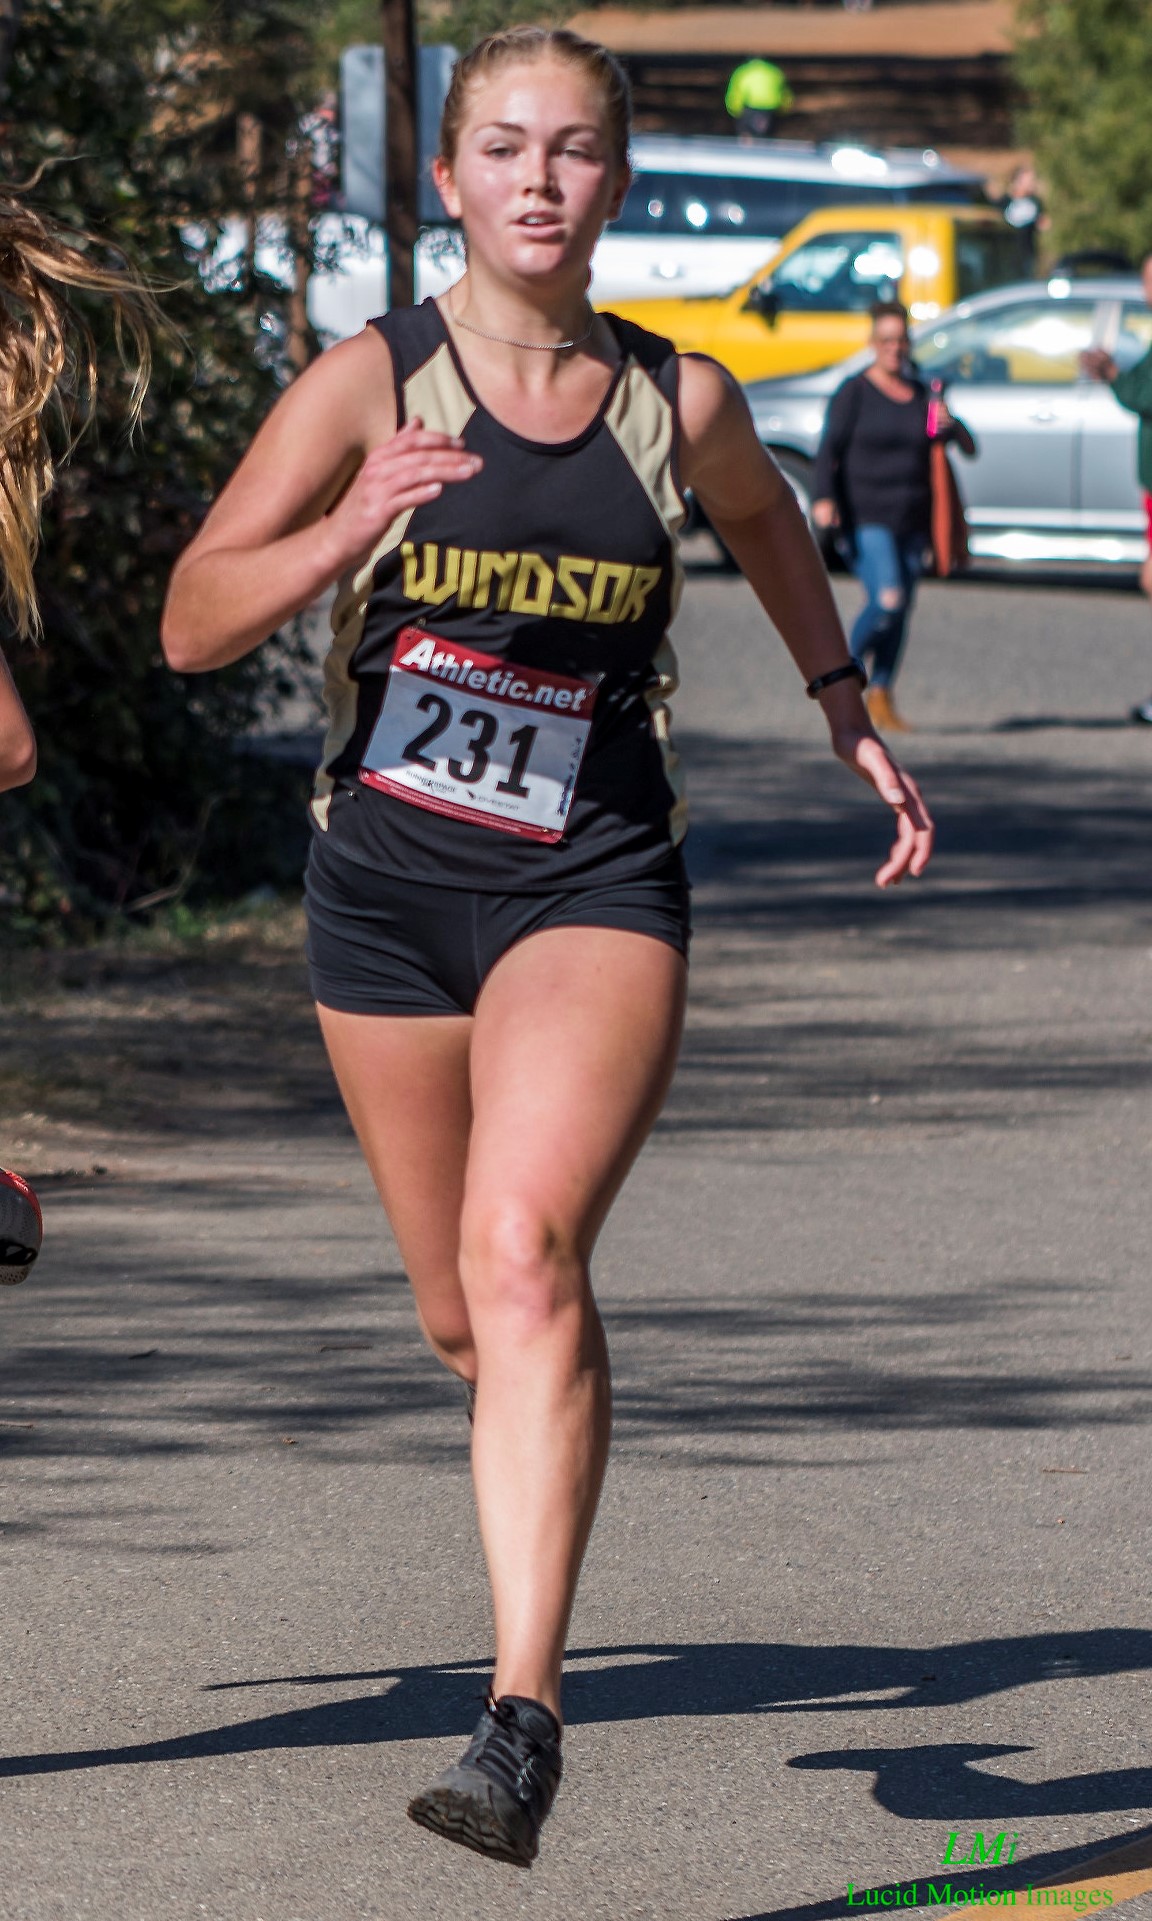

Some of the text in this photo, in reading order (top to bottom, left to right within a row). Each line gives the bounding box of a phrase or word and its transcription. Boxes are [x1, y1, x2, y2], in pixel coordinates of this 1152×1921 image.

[401, 541, 662, 624] WINDSOR
[399, 638, 587, 711] Athletic.net
[401, 693, 540, 798] 231
